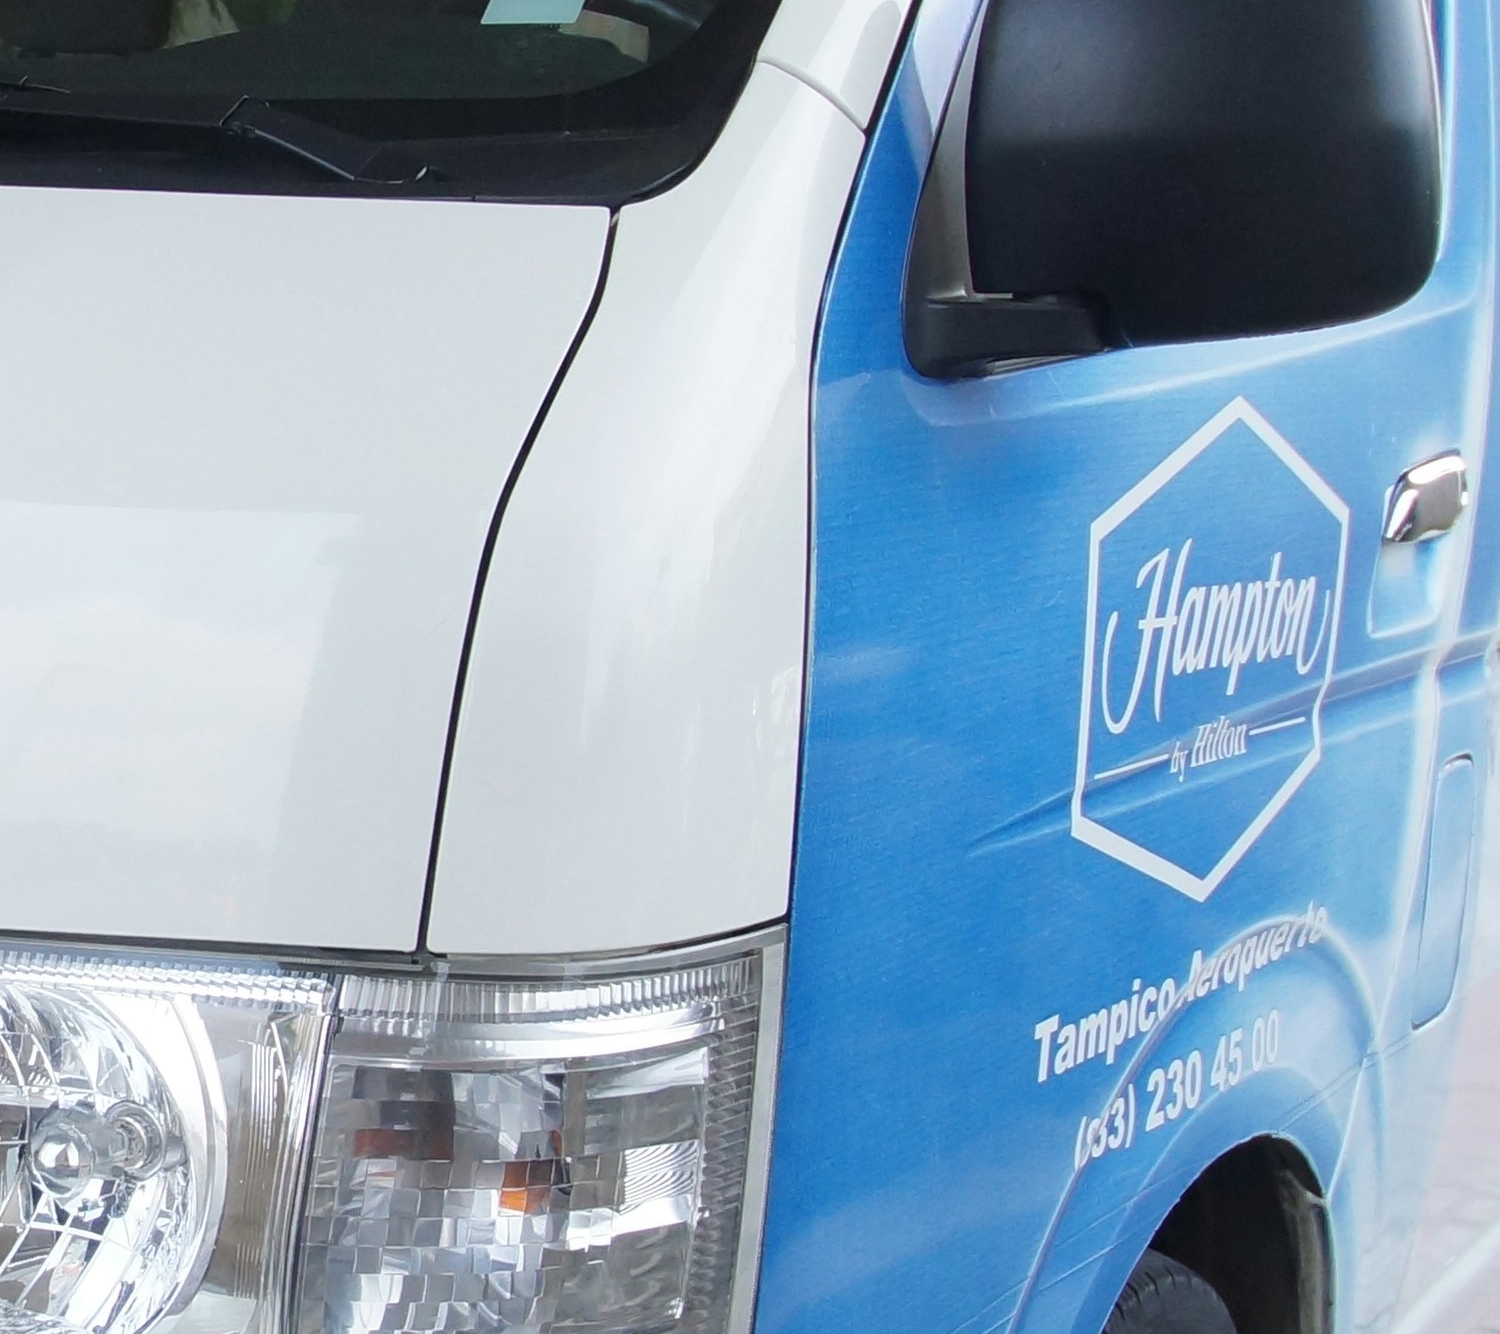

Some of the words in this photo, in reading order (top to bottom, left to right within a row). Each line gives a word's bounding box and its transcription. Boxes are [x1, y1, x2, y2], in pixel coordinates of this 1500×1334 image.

[1101, 537, 1331, 735] Hampton
[1169, 741, 1189, 782] by
[1189, 715, 1248, 769] Hilton
[1034, 978, 1177, 1083] Tampico
[1145, 1049, 1202, 1132] 230
[1210, 1027, 1244, 1092] 45
[1252, 1009, 1279, 1072] 00
